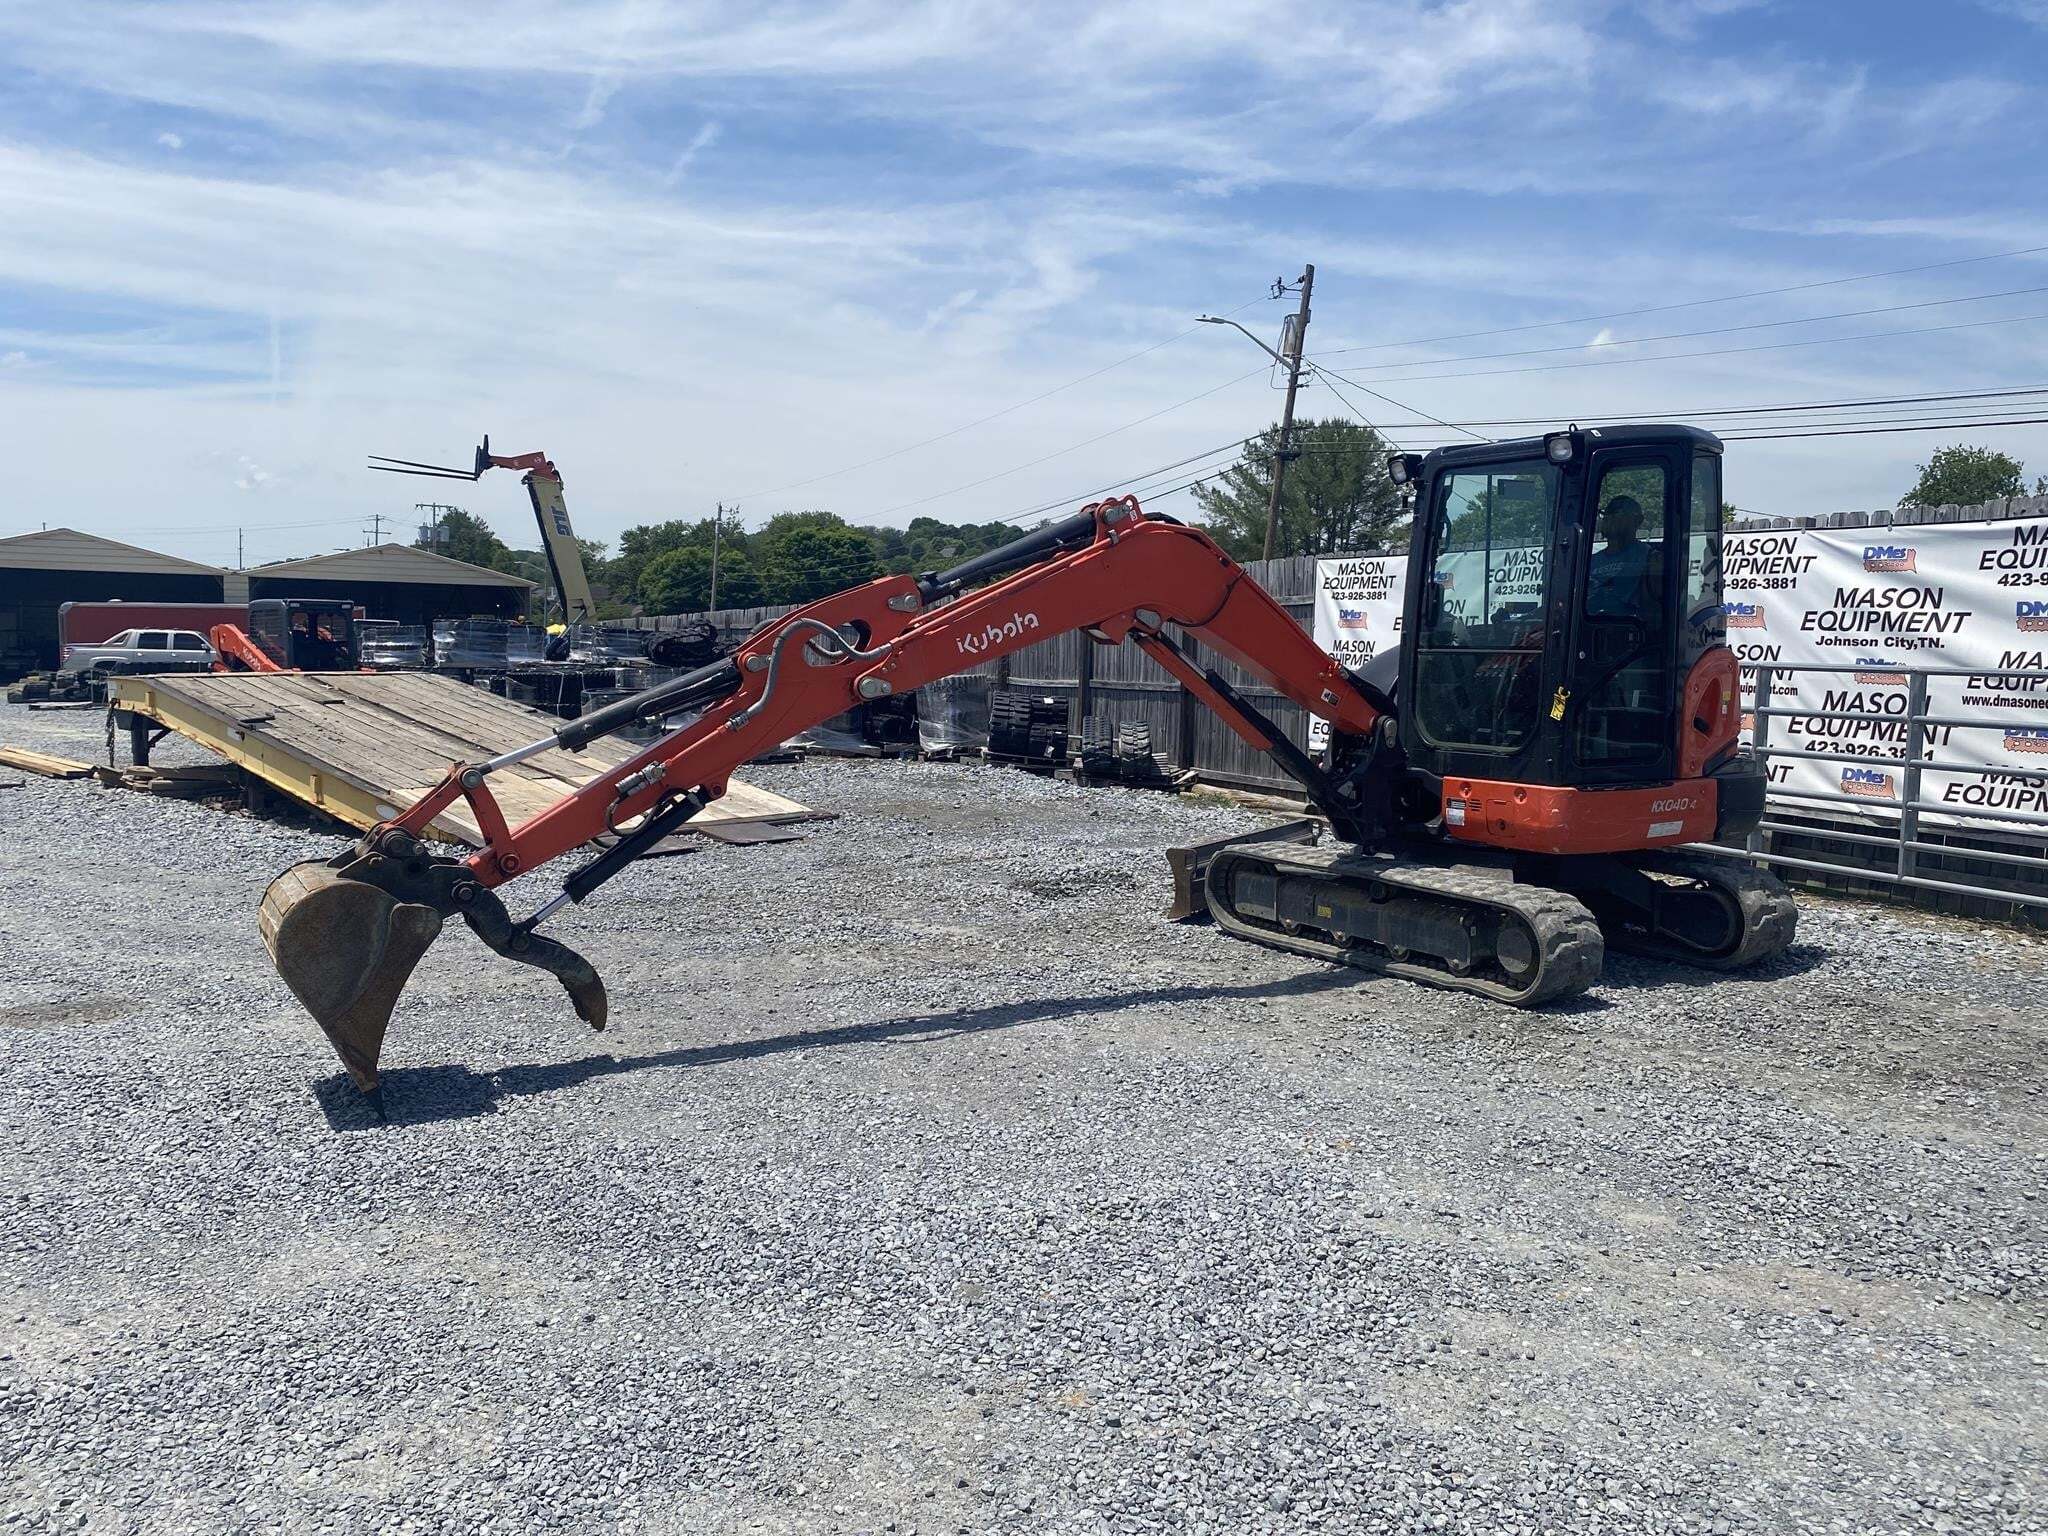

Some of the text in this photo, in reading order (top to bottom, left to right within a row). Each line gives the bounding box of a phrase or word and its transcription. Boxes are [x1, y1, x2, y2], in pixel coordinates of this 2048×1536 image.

[1338, 561, 1385, 576] MASON
[1323, 576, 1396, 589] EQUIPMENT
[1833, 588, 1943, 609] MASON
[1800, 610, 1972, 633] EQUIPMENT
[956, 612, 1039, 653] Kubota
[1333, 640, 1375, 652] MASON
[1816, 636, 1878, 647] Johnson
[1841, 767, 1884, 783] DMes
